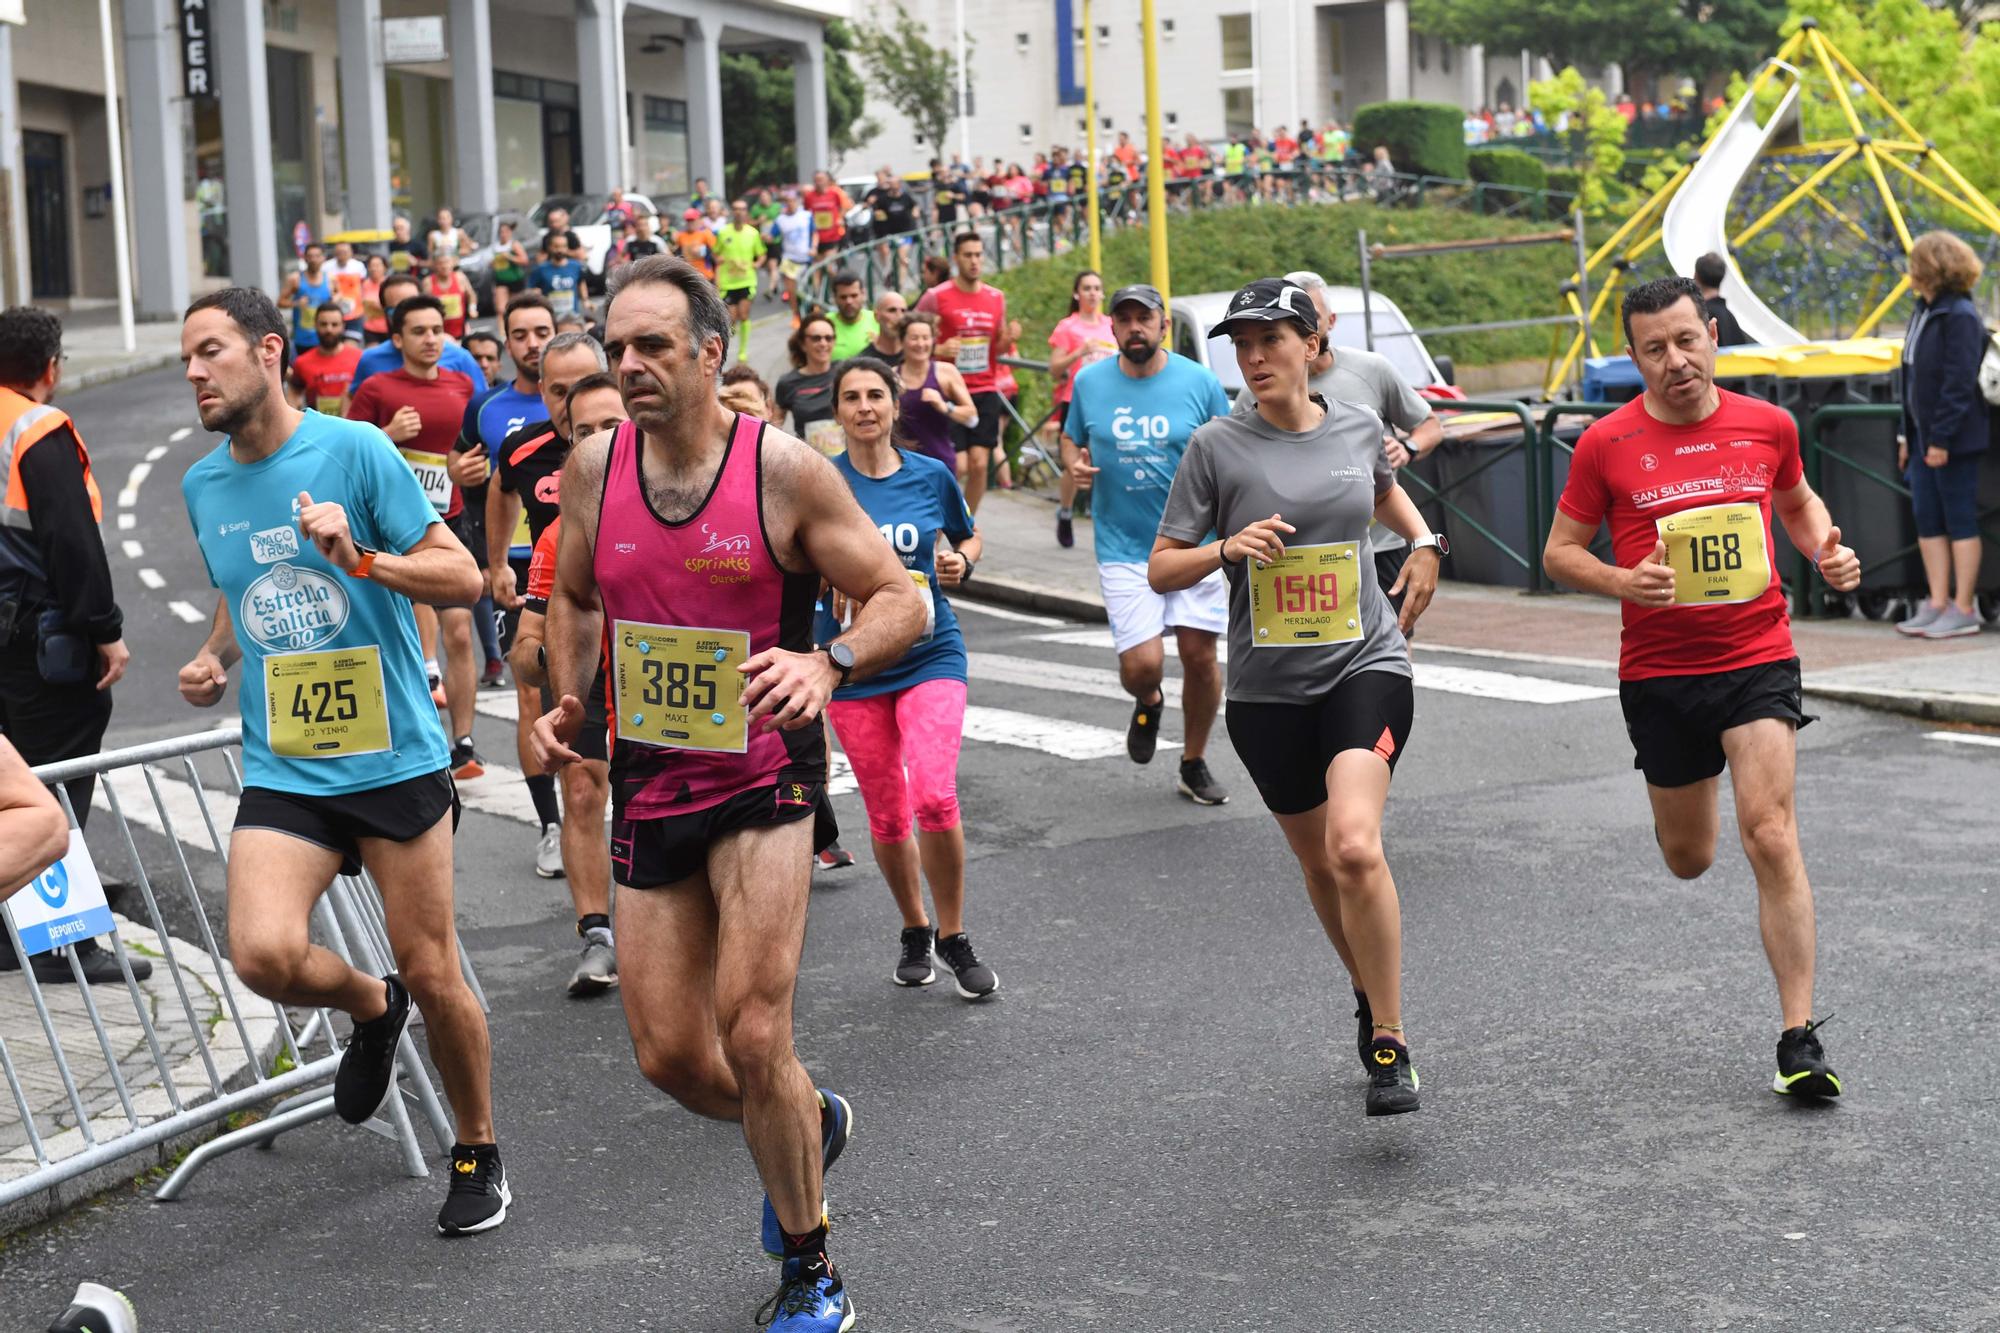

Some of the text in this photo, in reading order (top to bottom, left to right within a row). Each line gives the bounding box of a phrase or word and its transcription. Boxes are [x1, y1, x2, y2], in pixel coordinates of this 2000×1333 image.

[414, 468, 446, 493] 004
[1632, 491, 1658, 505] SAN
[1660, 478, 1723, 498] SILVESTRE
[251, 529, 293, 548] XACO
[267, 544, 298, 558] RUN
[879, 523, 919, 553] 10
[1689, 533, 1742, 573] 168
[1708, 575, 1729, 584] FRAN
[253, 584, 331, 617] Estrella
[1273, 573, 1339, 613] 1519
[262, 604, 333, 638] Galicia
[1284, 616, 1331, 625] MERINLAGO
[642, 659, 717, 710] 385
[292, 679, 358, 724] 425
[304, 725, 349, 737] DJ YINHO
[665, 713, 689, 724] MAXI
[48, 919, 86, 938] DEPORTES
